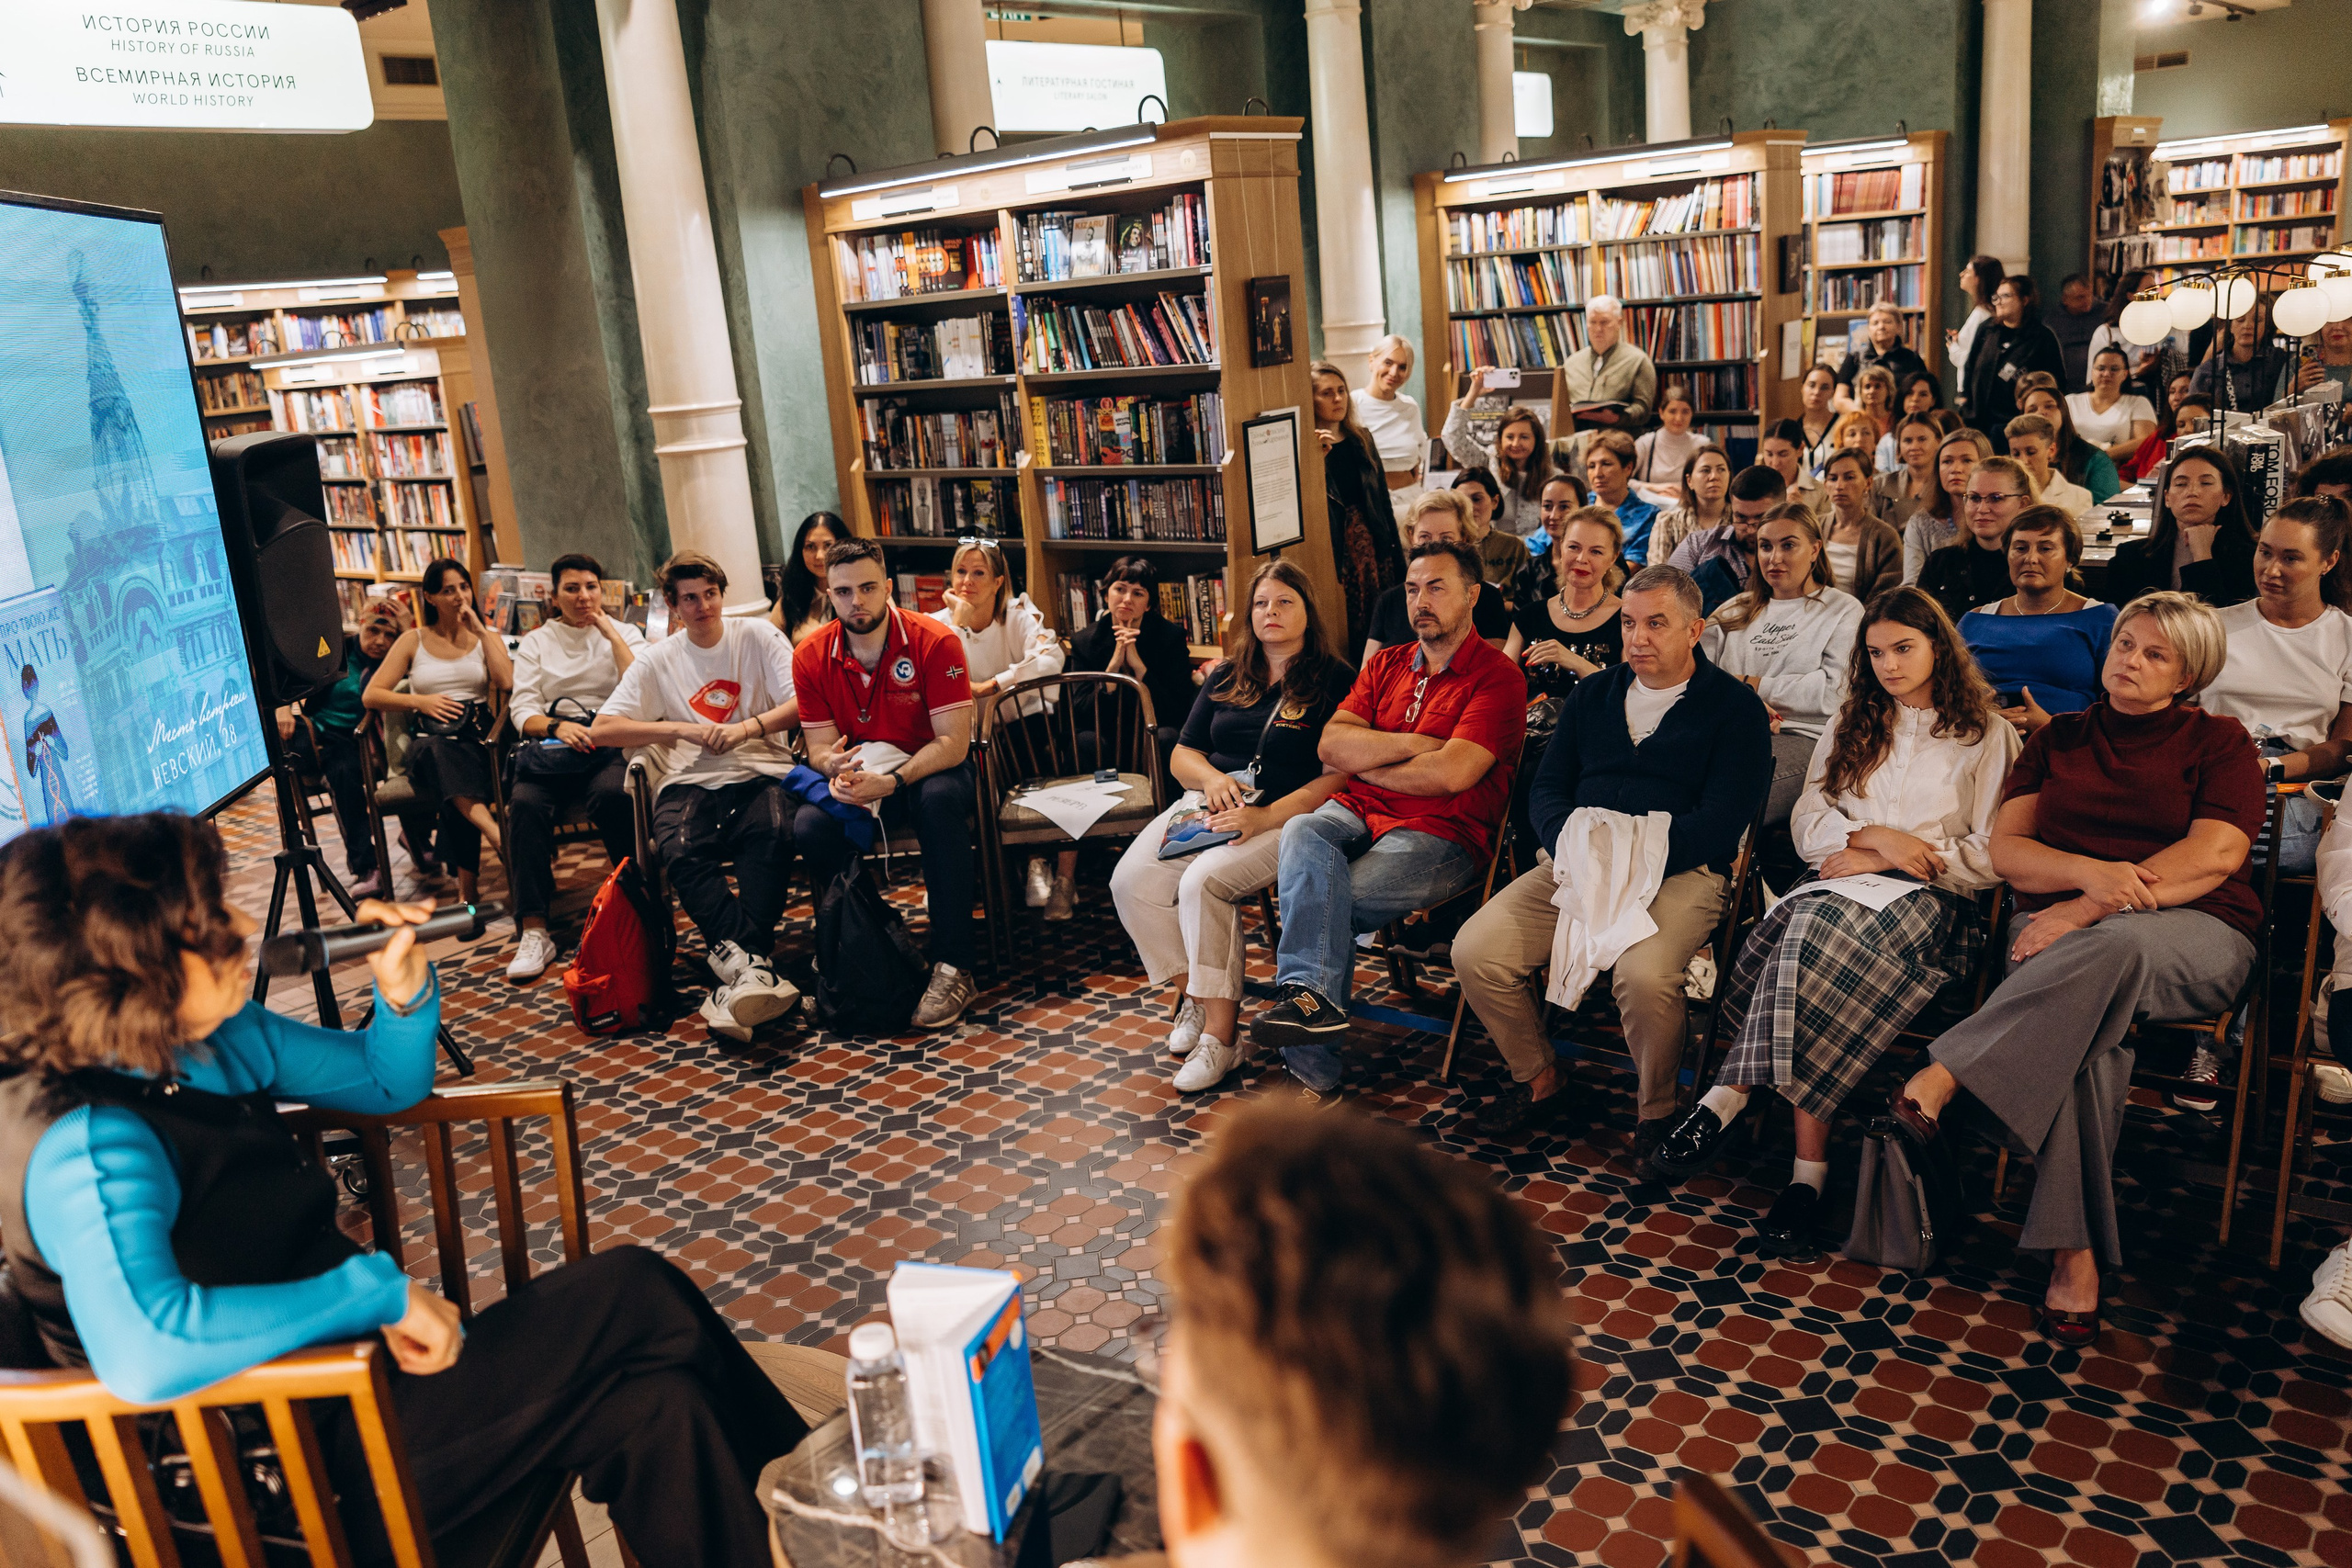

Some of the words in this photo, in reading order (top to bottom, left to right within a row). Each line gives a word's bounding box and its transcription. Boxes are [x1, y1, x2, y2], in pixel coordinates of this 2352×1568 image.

[82, 14, 181, 35] ИСТОРИЯ
[188, 21, 270, 40] РОССИИ
[111, 39, 175, 53] HISTORY
[179, 42, 199, 55] OF
[205, 44, 255, 58] RUSSIA
[75, 66, 201, 87] ВСЕМИРНАЯ
[208, 73, 297, 90] ИСТОРИЯ
[1022, 76, 1088, 87] ЛИТЕРАТУРНАЯ
[1091, 78, 1136, 89] ГОСТИНАЯ
[133, 92, 188, 107] WORLD
[194, 95, 254, 107] HISTORY
[1075, 220, 1104, 230] KIZARU
[2250, 453, 2258, 473] FORD
[2267, 439, 2280, 473] TOM
[0, 620, 18, 638] ПРО
[19, 611, 46, 631] ТВОЮ
[48, 606, 61, 622] ЖЕ
[1762, 623, 1795, 635] Upper
[1749, 635, 1776, 644] East
[4, 626, 68, 678] МАТЬ
[147, 717, 197, 754] Место
[198, 691, 247, 734] встречи
[152, 733, 221, 790] НЕВСКИЙ,
[221, 723, 237, 748] 28
[1293, 991, 1320, 1017] N
